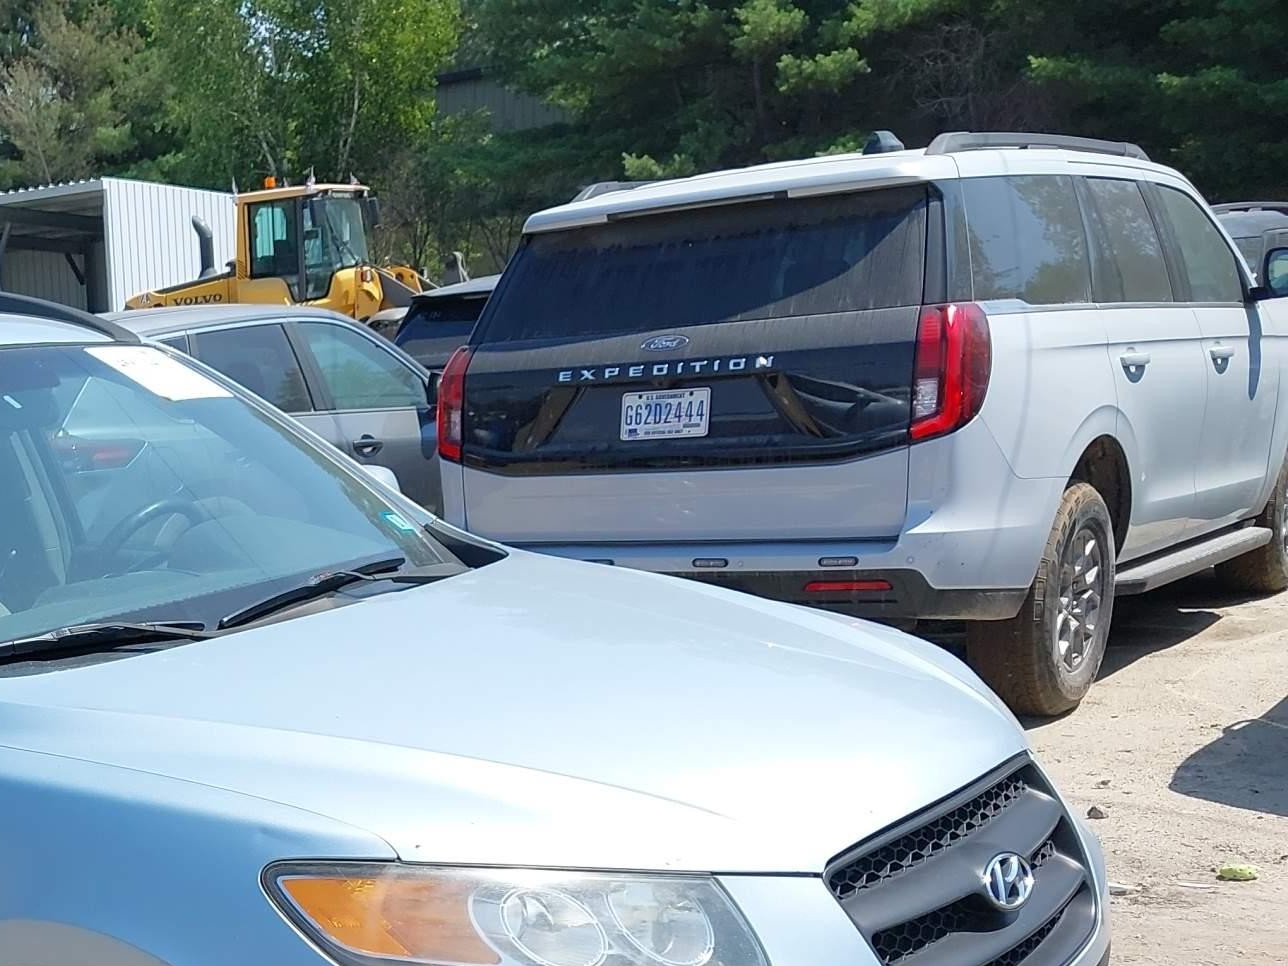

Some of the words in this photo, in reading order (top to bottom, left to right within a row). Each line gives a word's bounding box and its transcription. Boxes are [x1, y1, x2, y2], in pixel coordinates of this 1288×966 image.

[173, 293, 223, 307] VOLVO
[647, 336, 682, 350] Ford
[558, 355, 775, 383] EXPEDITION
[624, 400, 705, 426] G62D2444
